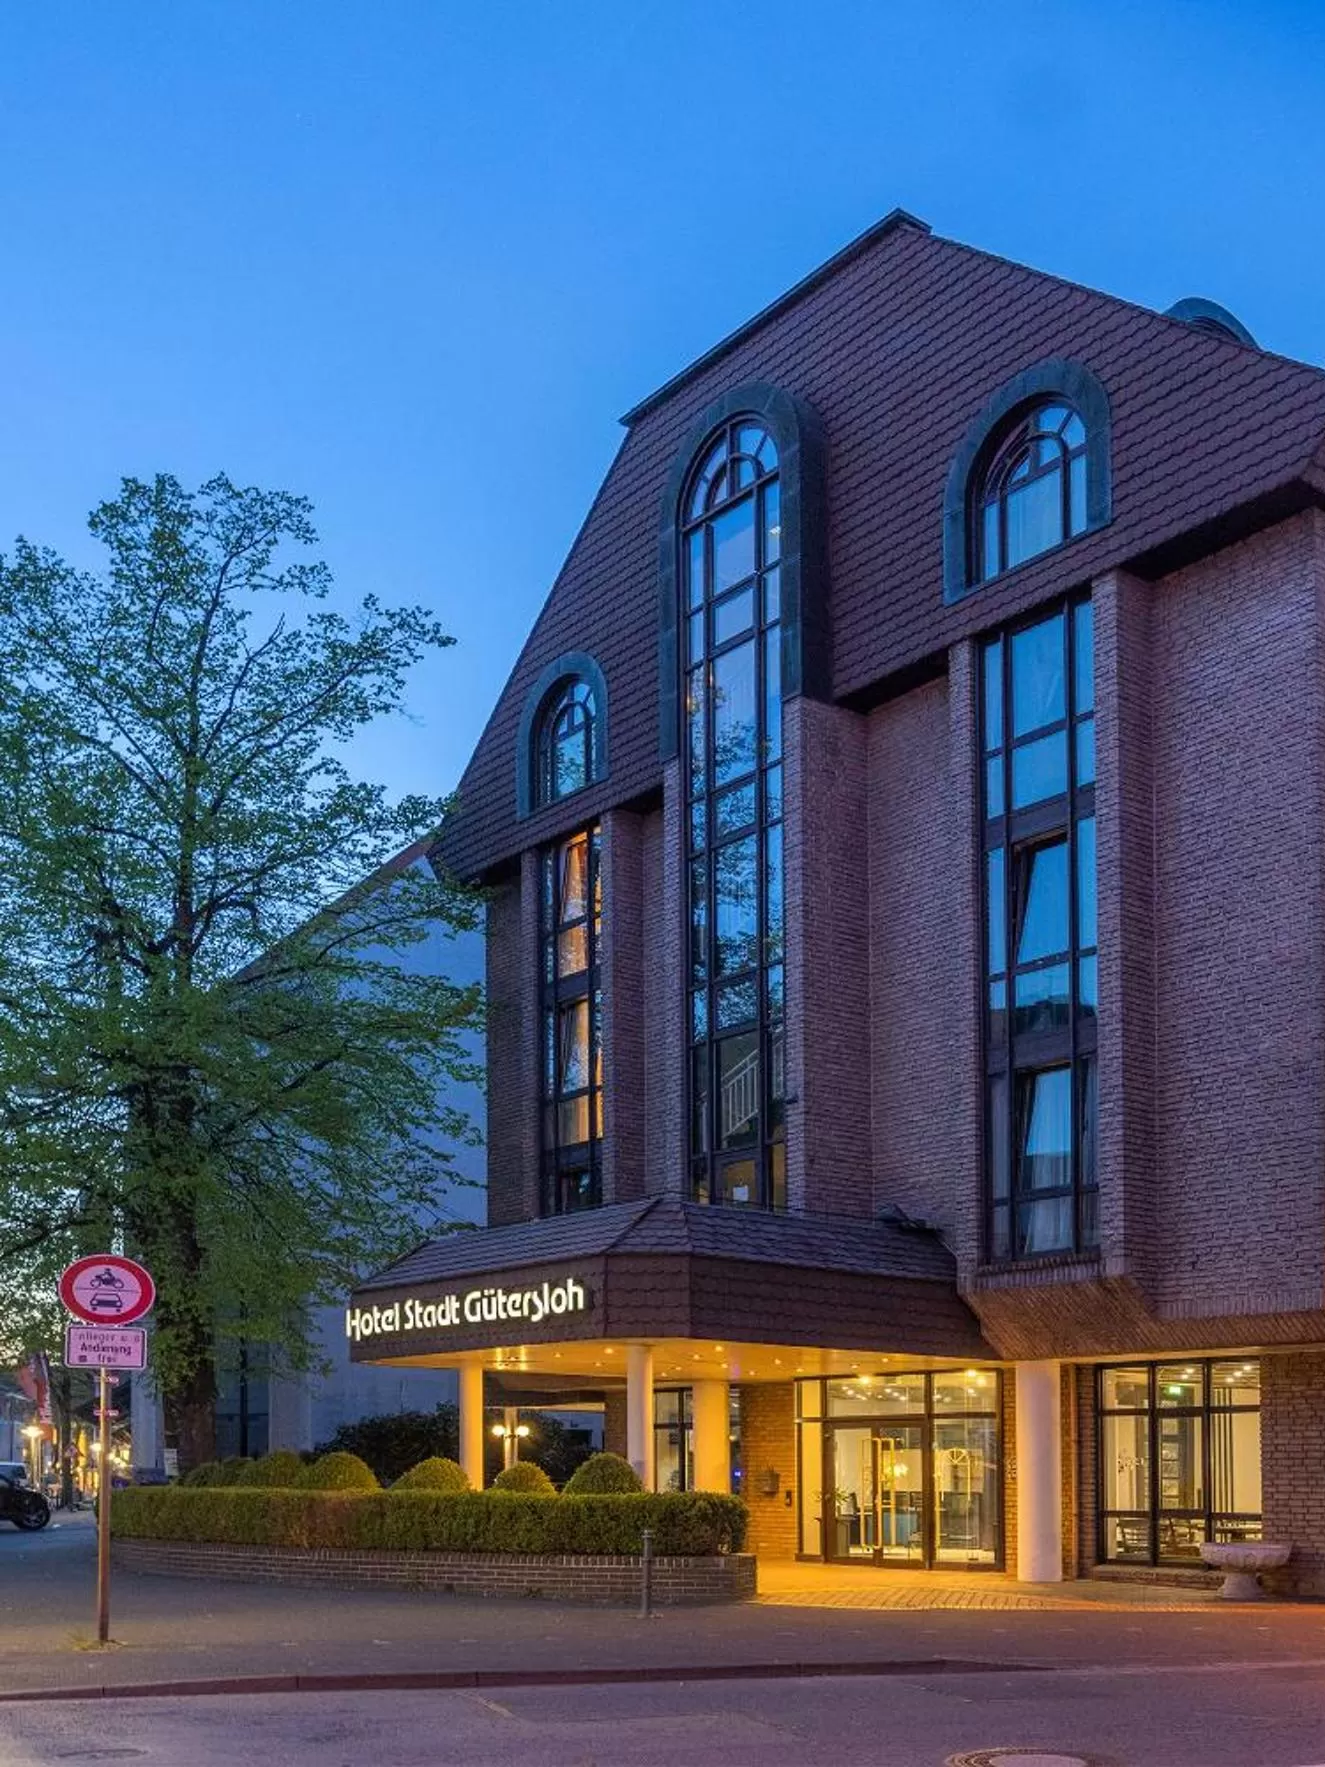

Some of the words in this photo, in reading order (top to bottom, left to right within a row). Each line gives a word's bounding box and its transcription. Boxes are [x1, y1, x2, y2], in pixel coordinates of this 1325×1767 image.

[345, 1302, 400, 1341] Hotel
[404, 1294, 460, 1330] Stadt
[464, 1278, 584, 1322] Gütersloh
